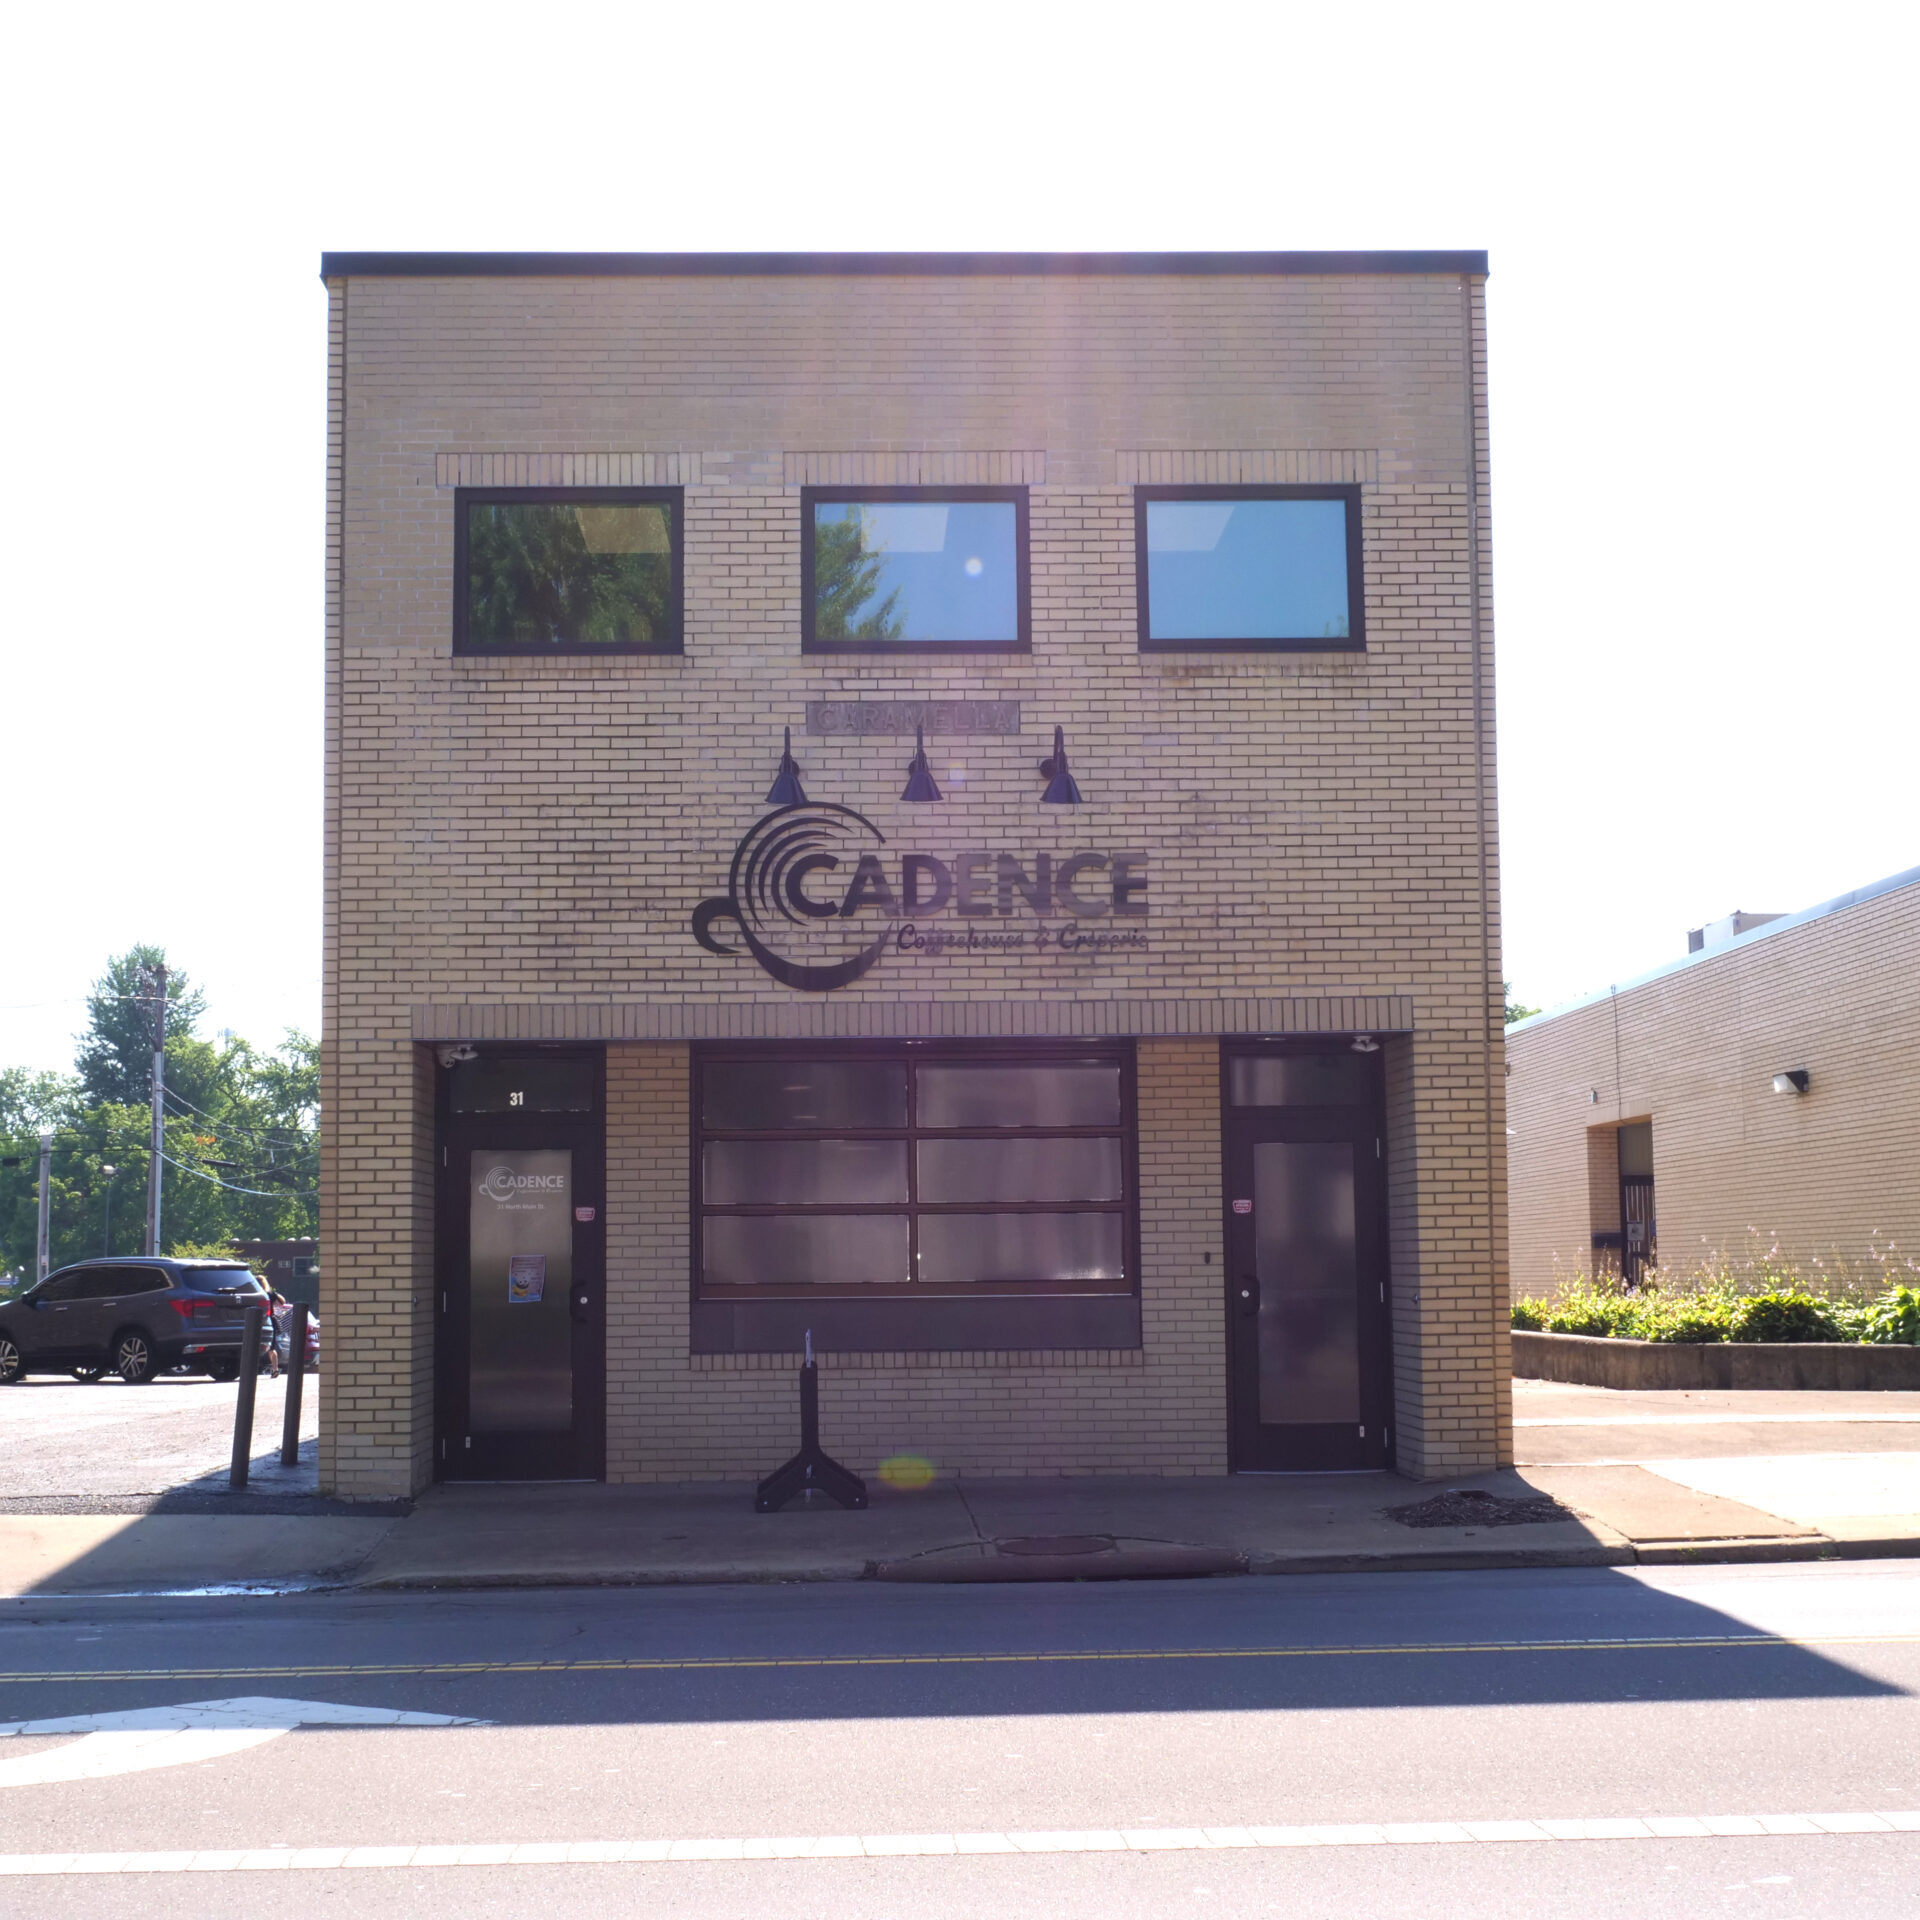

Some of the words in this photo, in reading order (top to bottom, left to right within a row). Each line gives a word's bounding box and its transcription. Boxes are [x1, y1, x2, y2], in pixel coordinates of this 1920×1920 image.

[785, 852, 1149, 918] CADENCE
[896, 923, 1024, 956] Coffeehouse
[1034, 925, 1050, 948] &
[509, 1091, 524, 1106] 31
[496, 1175, 564, 1188] CADENCE
